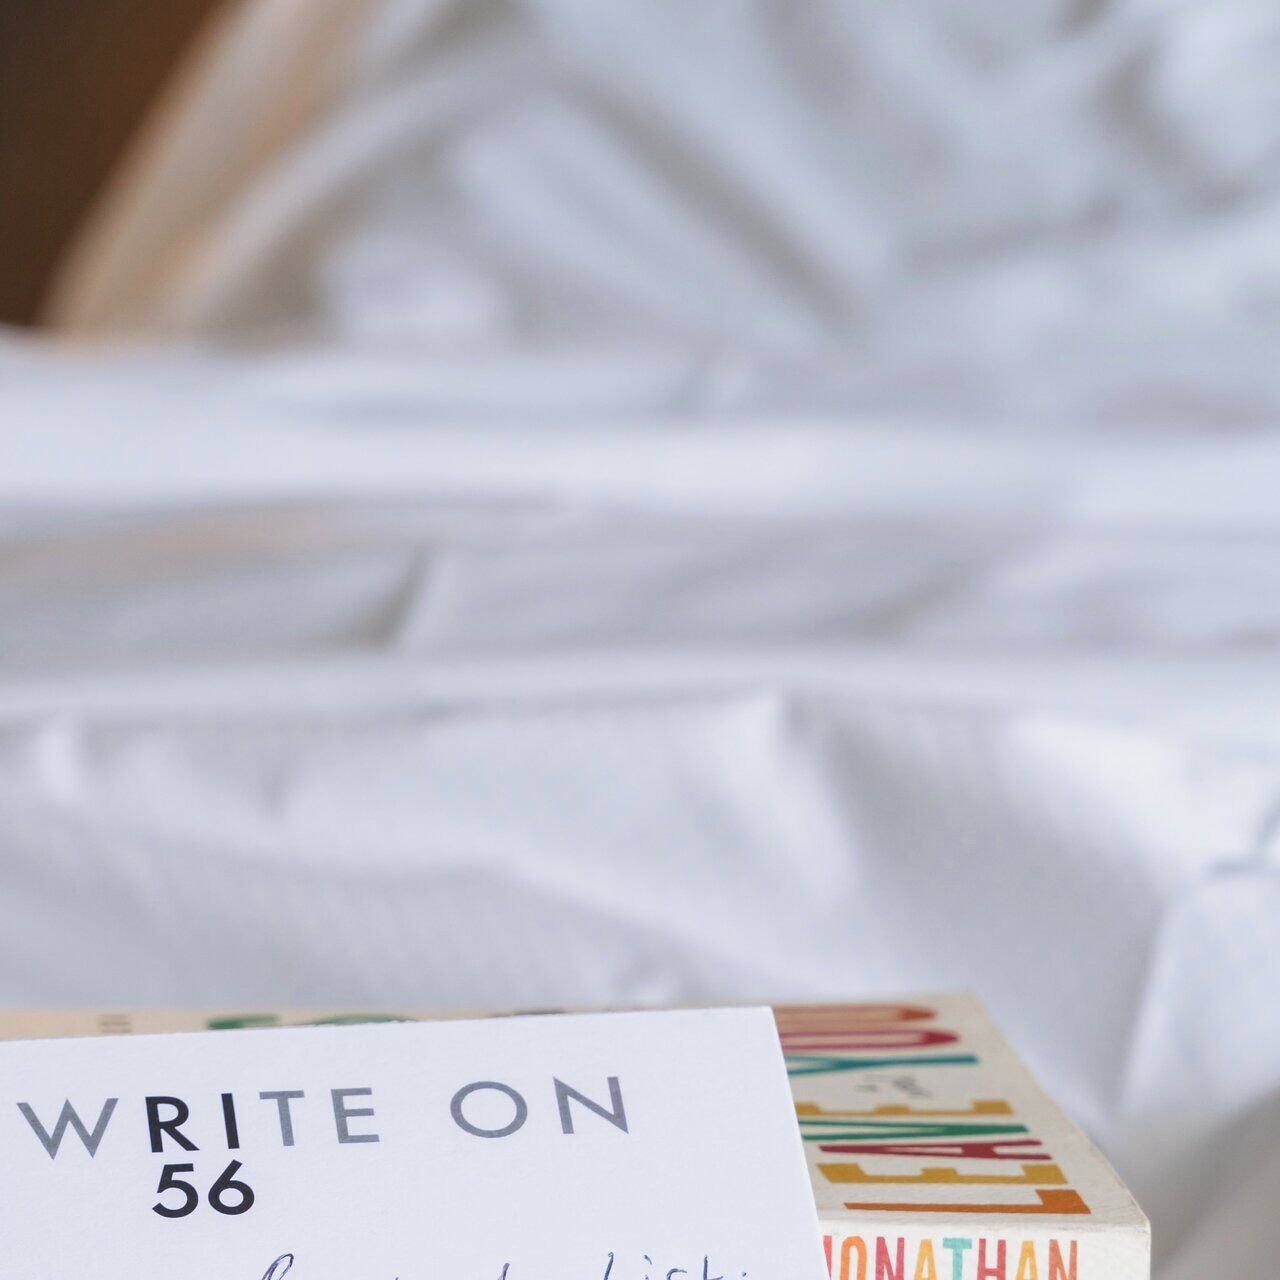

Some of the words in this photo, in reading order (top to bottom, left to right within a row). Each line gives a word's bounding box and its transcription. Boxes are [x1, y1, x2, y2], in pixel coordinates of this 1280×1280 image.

[16, 1088, 380, 1160] WRITE
[450, 1076, 629, 1138] ON
[795, 1100, 1091, 1214] LEAVE
[152, 1159, 255, 1218] 56
